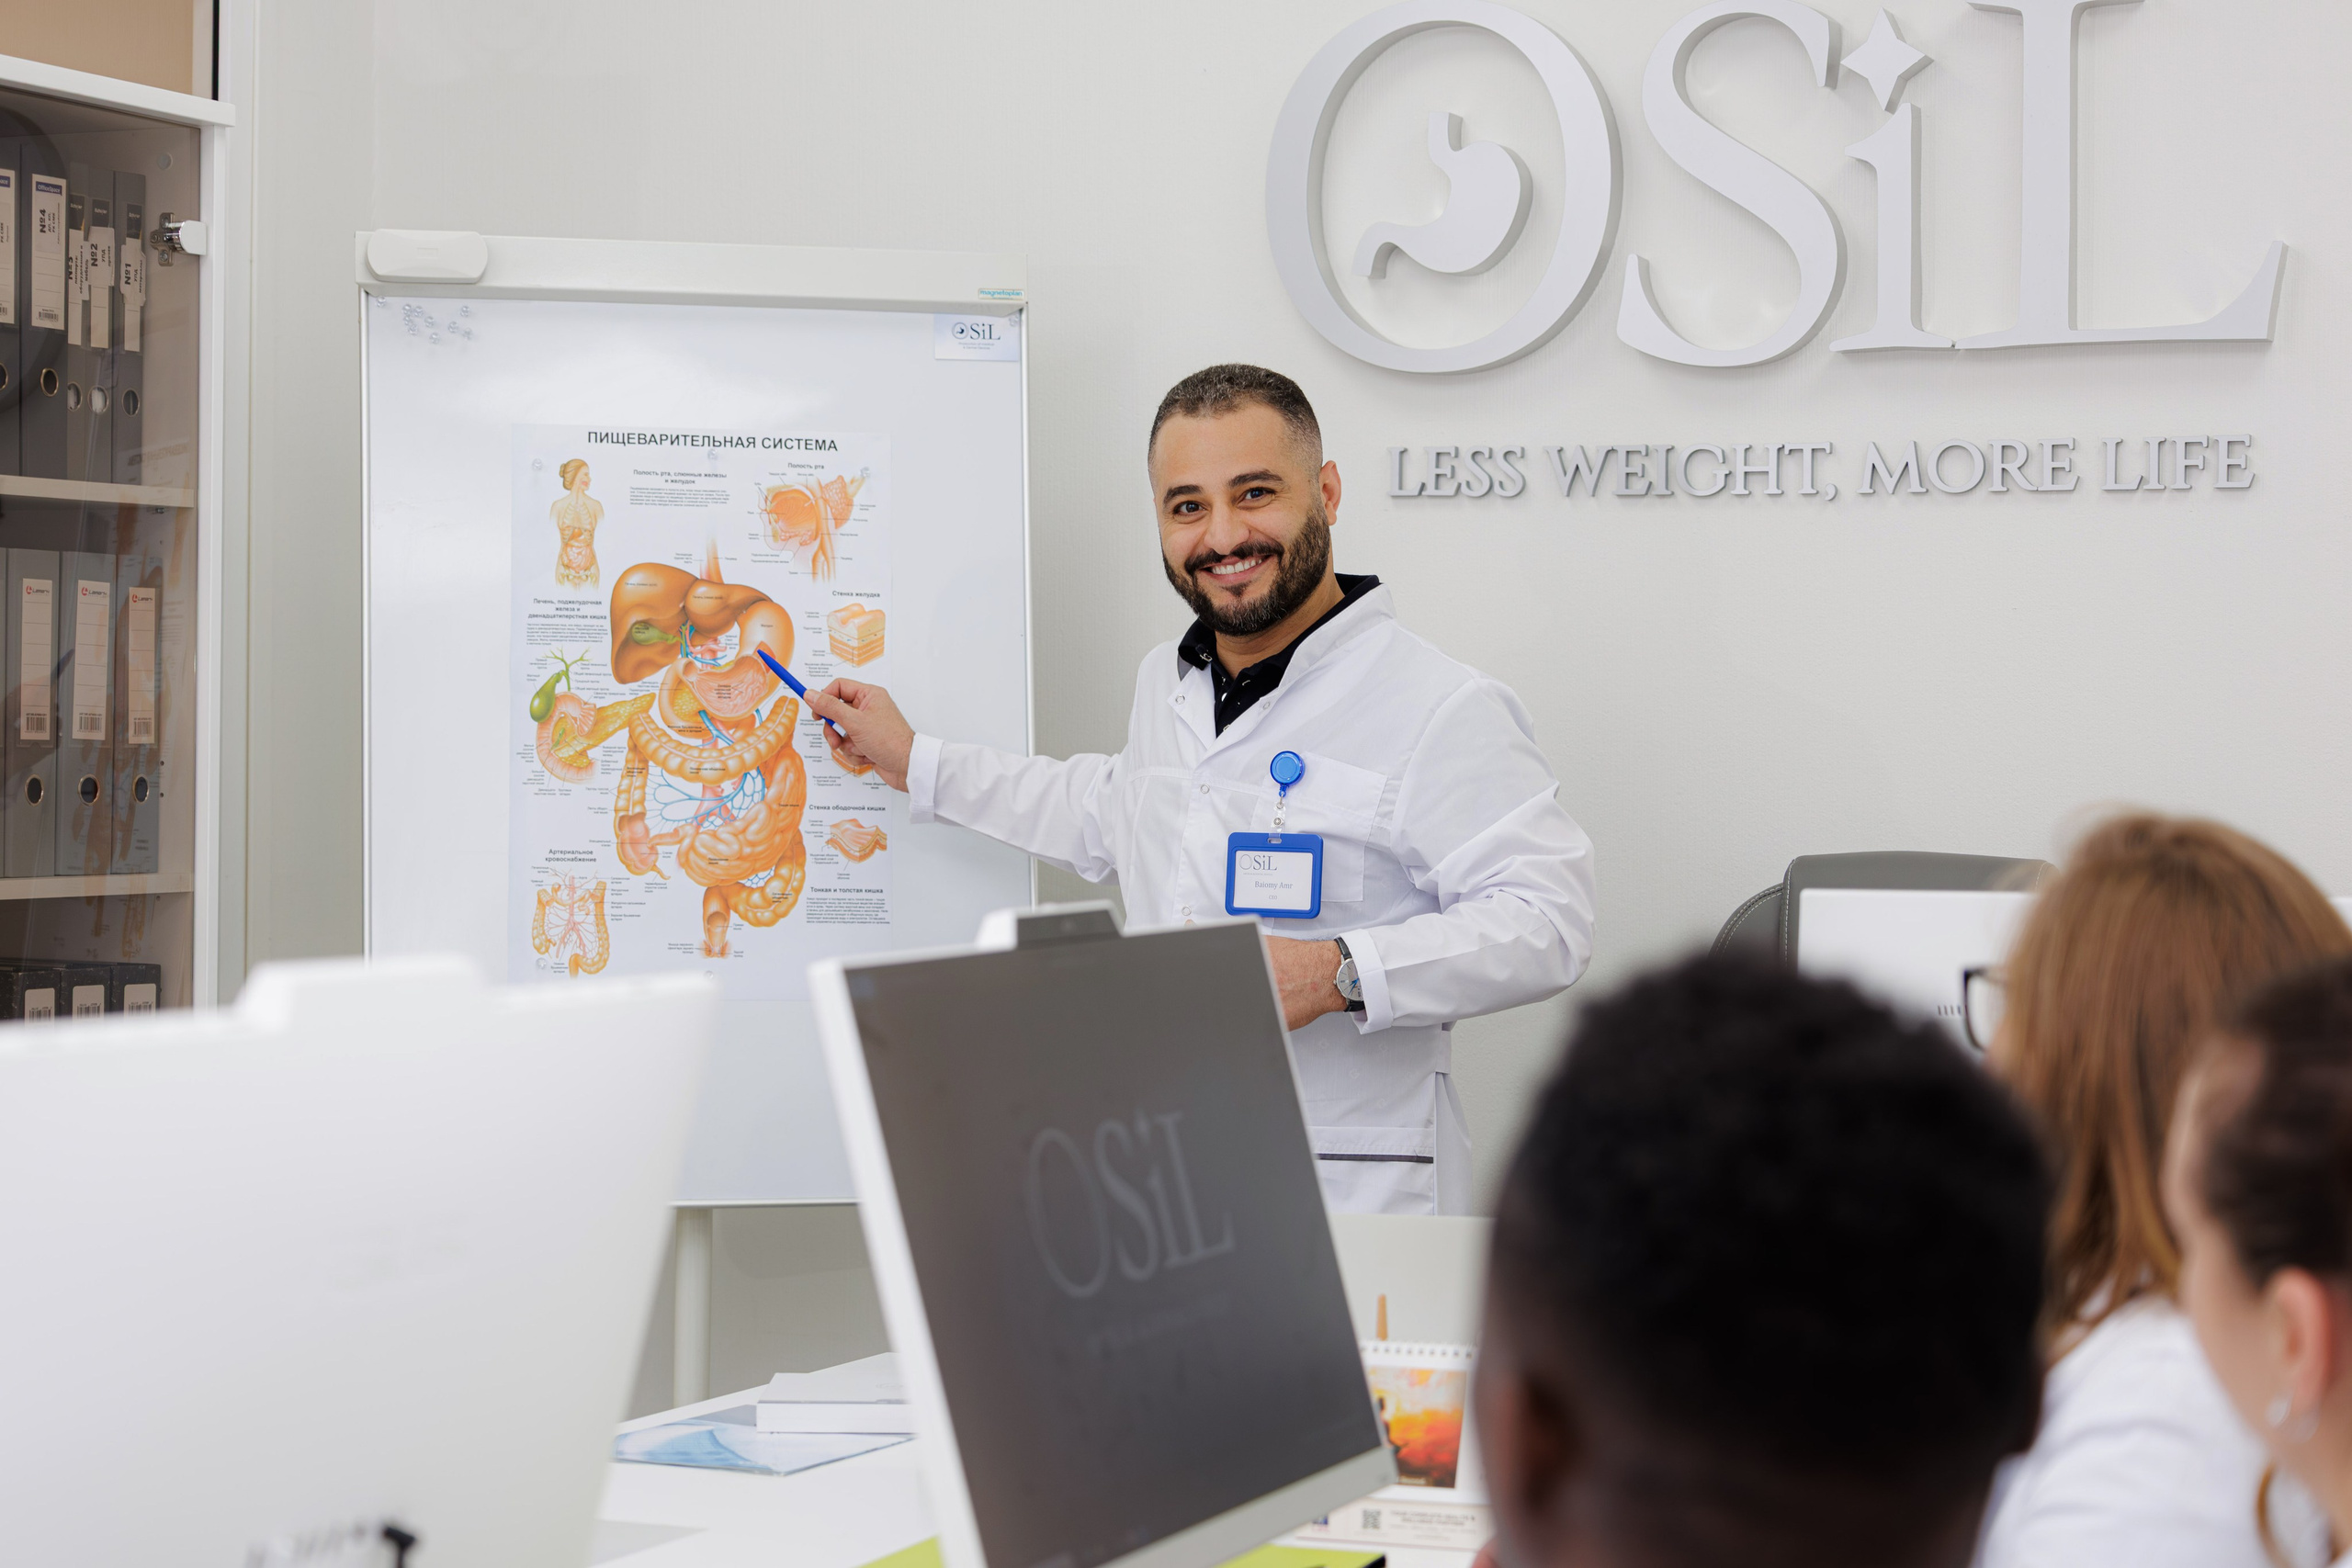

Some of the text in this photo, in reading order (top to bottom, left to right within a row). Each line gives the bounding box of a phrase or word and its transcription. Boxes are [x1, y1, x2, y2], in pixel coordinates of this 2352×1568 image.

[1265, 0, 2288, 375] OSiL
[952, 321, 1001, 340] OSiL
[588, 431, 838, 451] ПИЩЕВАРИТЕЛЬНАЯ СИСТЕМА
[1386, 434, 2256, 502] LESS WEIGHT, MORE LIFE
